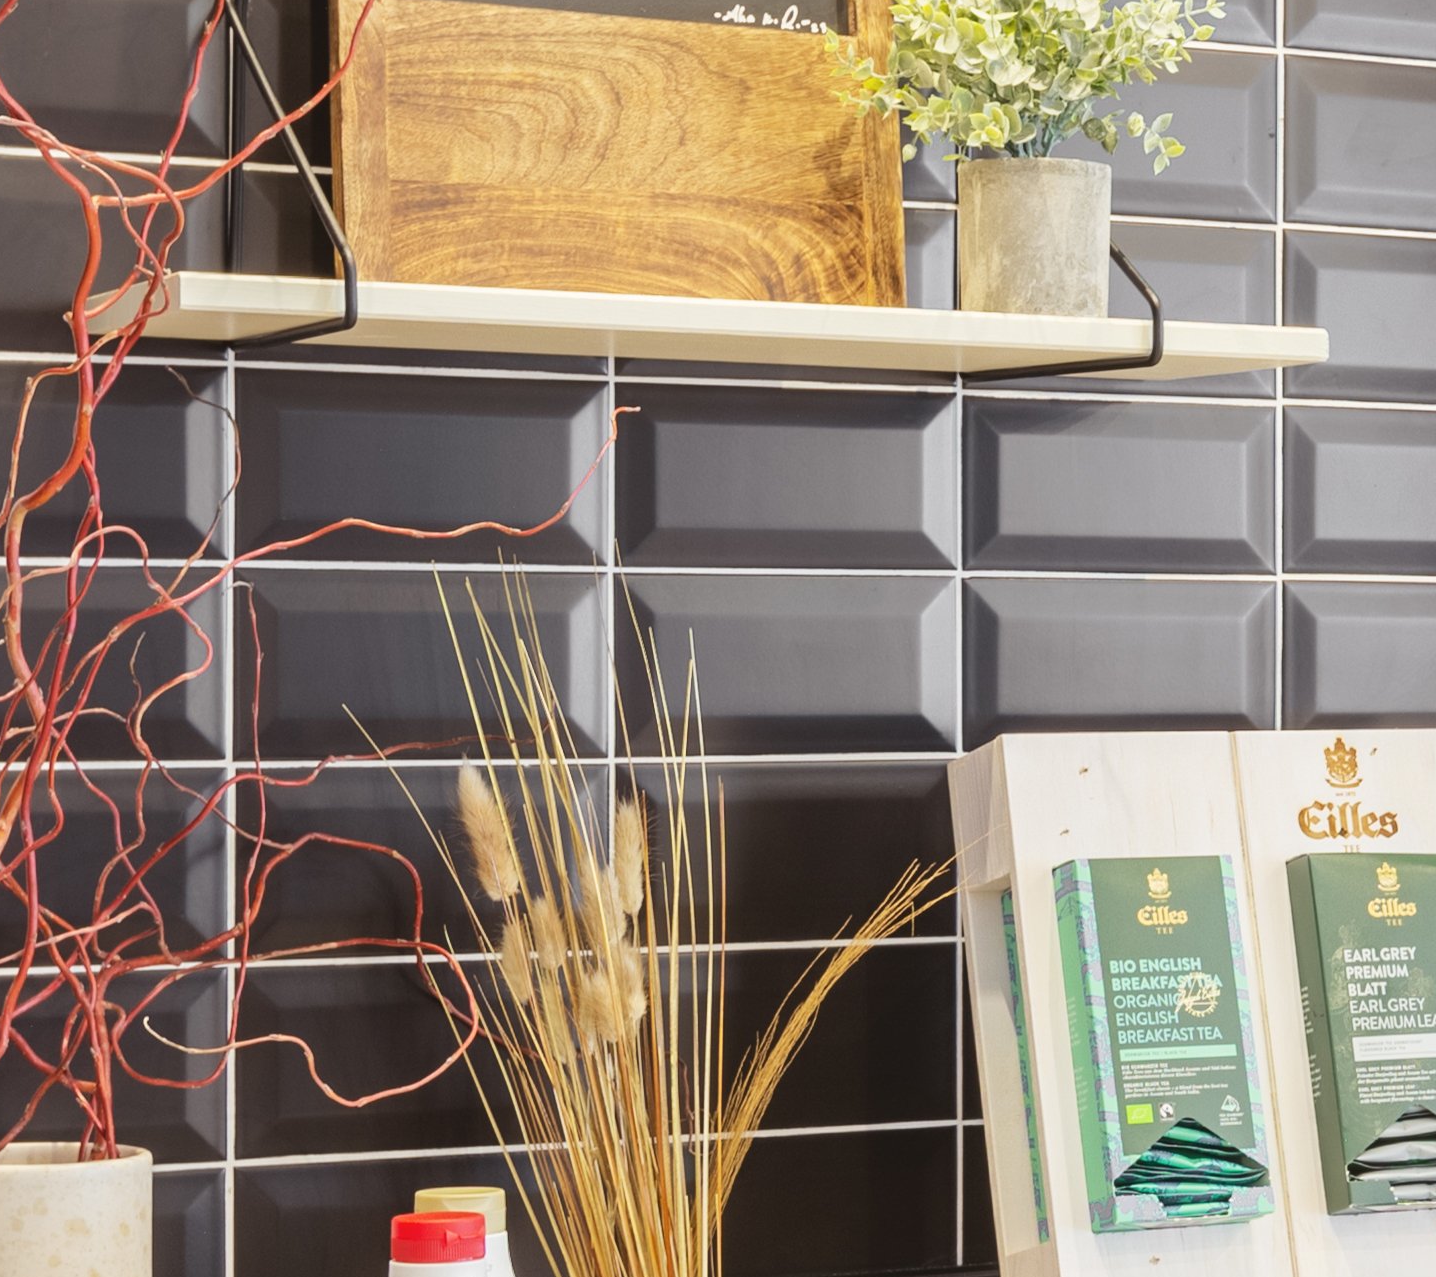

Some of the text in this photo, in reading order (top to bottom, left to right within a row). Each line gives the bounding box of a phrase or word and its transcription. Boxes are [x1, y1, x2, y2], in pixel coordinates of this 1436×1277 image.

[1298, 800, 1399, 840] Eilles
[1137, 905, 1189, 926] Eilles
[1367, 897, 1417, 918] Eilles
[1156, 927, 1174, 935] TEE
[1343, 946, 1417, 963] EARL GREY
[1109, 957, 1202, 974] BIO ENGLISH
[1346, 964, 1409, 980] PREMIUM
[1347, 981, 1388, 997] BLATT
[1113, 993, 1184, 1009] ORGANIC
[1349, 997, 1426, 1014] EARL GREY
[1115, 1010, 1180, 1027] ENGLISH
[1352, 1015, 1415, 1031] PREMIUM
[1118, 1026, 1223, 1045] BREAKFAST TEA
